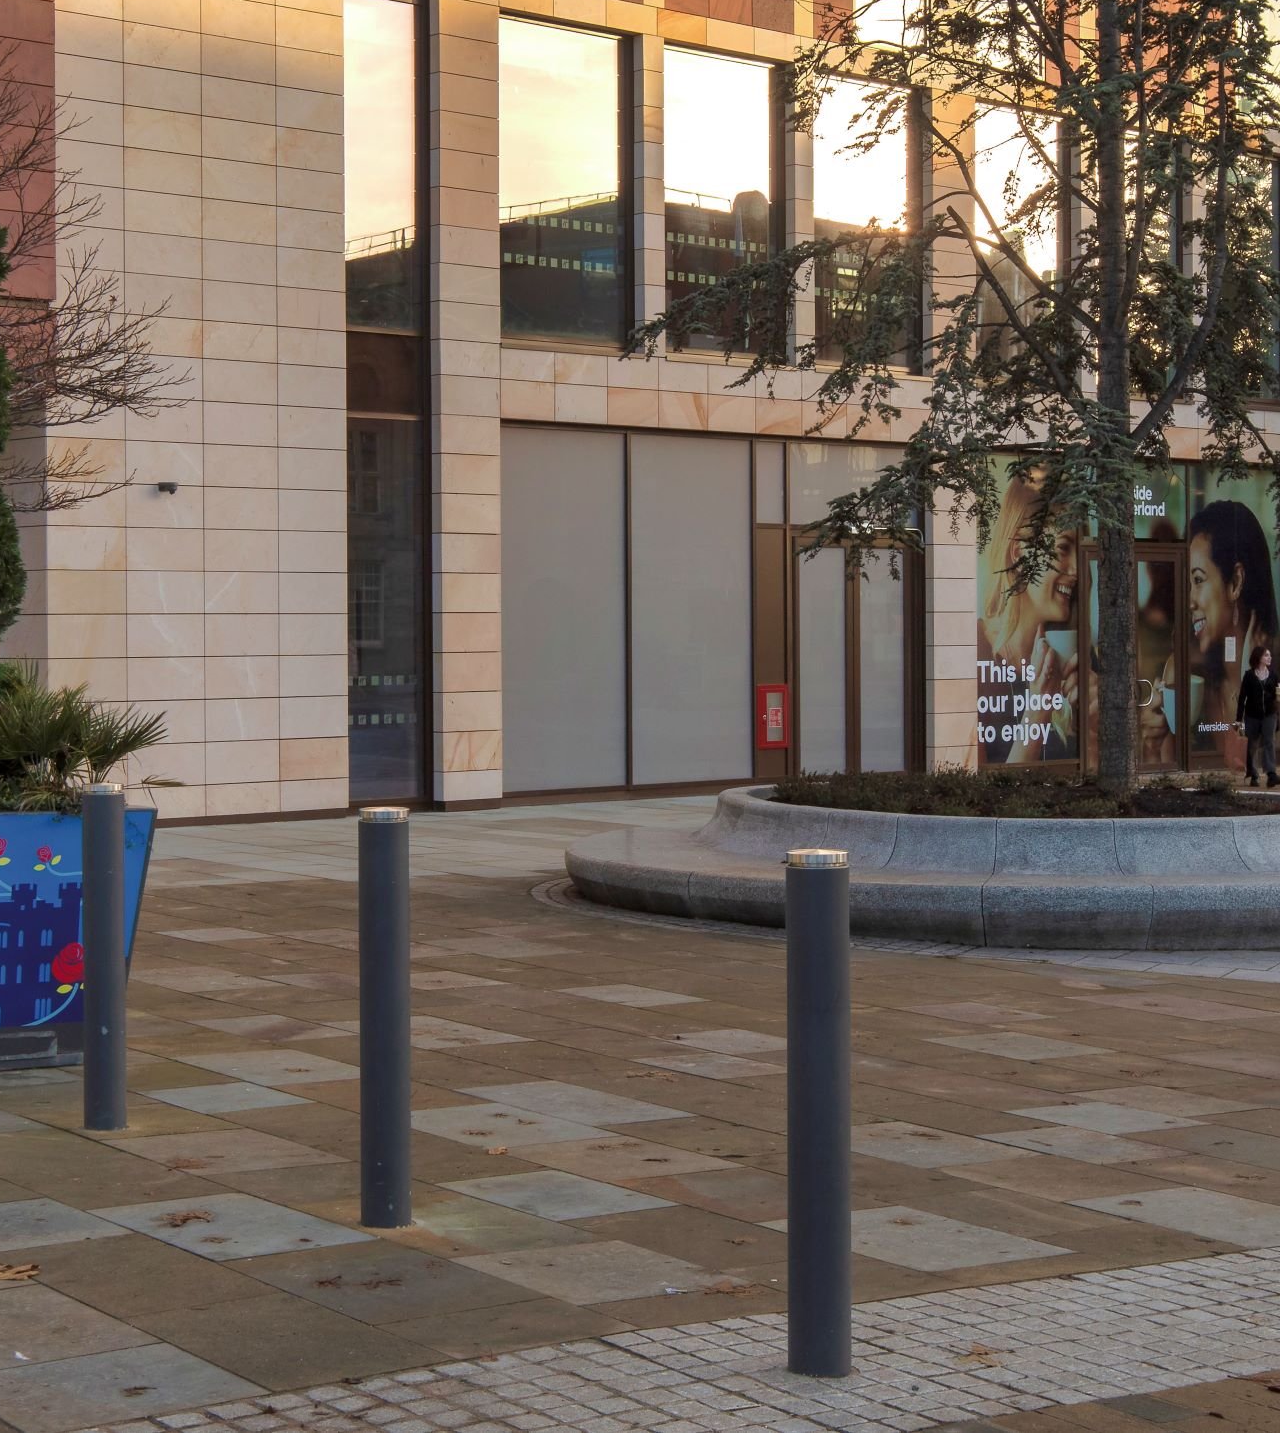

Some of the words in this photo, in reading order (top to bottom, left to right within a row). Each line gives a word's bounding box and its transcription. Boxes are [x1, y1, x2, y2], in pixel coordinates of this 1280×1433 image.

[977, 658, 1017, 683] This
[1021, 658, 1036, 682] is
[977, 694, 1009, 714] our
[1013, 688, 1064, 717] place
[977, 721, 997, 743] to
[1001, 717, 1052, 746] enjoy
